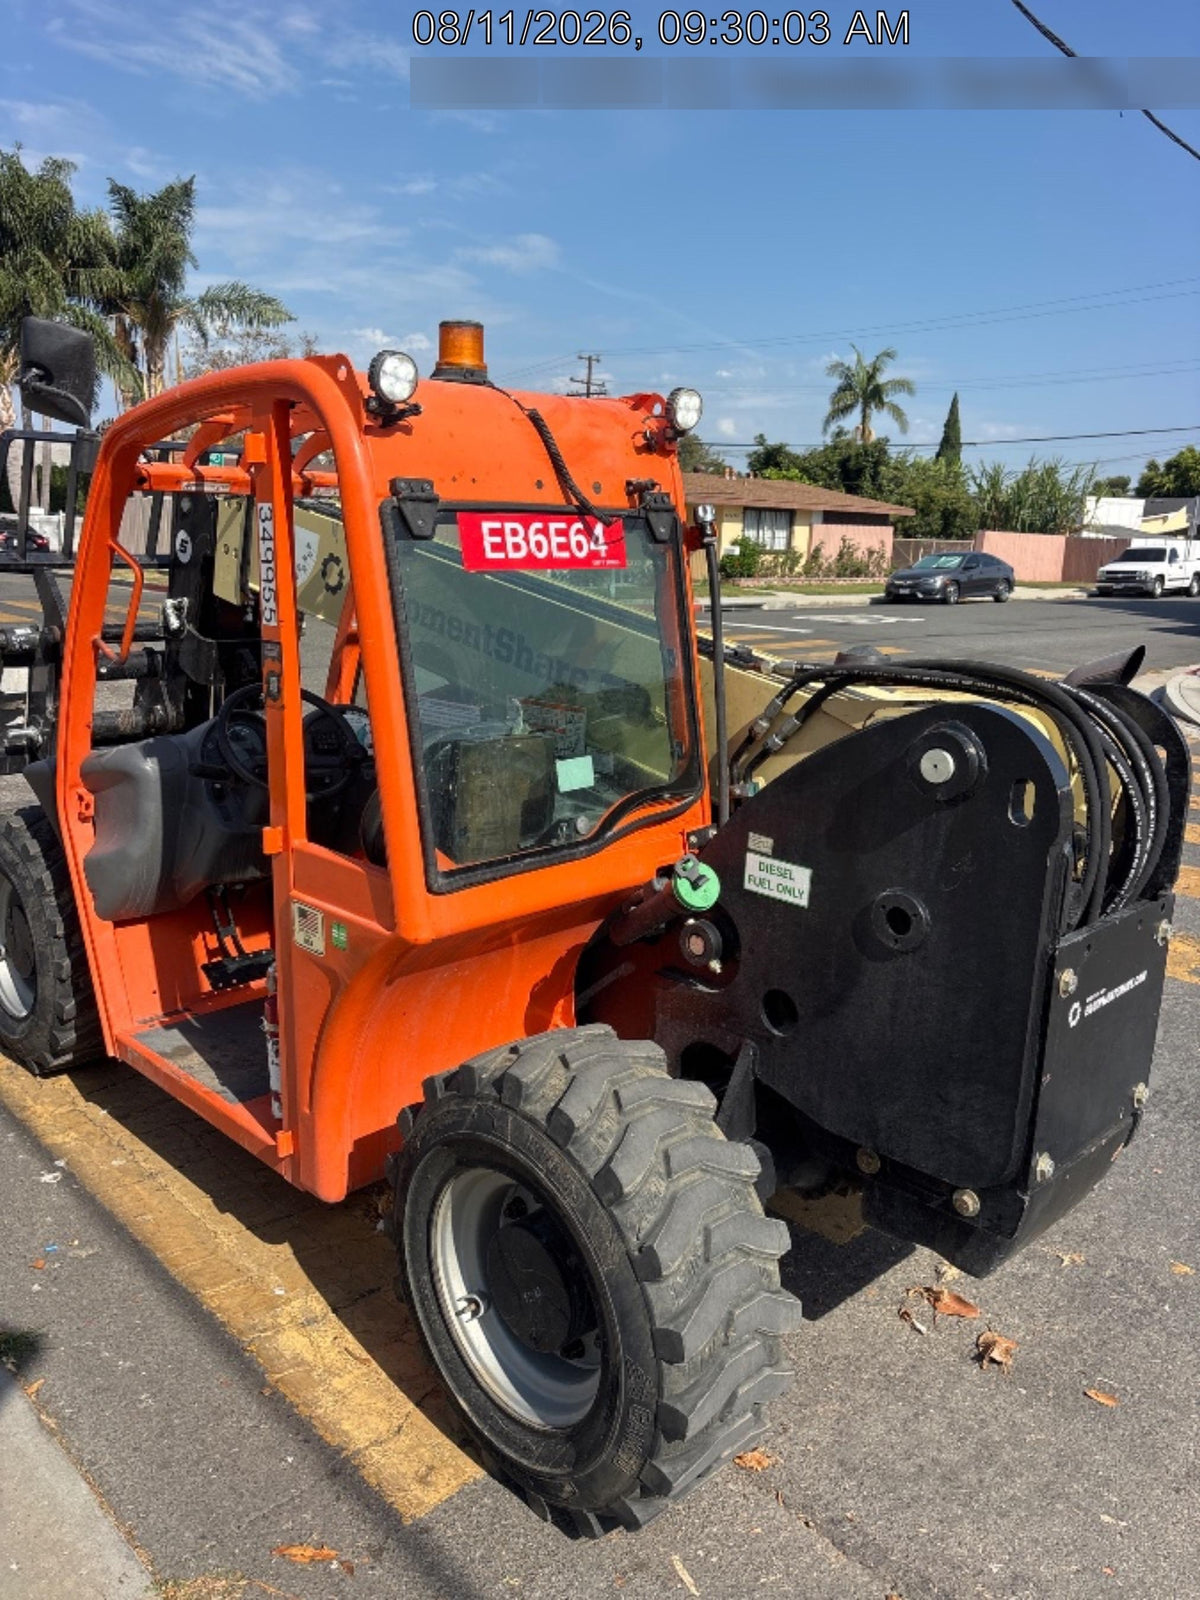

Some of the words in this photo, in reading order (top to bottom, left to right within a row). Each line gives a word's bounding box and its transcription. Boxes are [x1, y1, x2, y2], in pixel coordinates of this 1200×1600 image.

[481, 521, 608, 559] EB6E64
[259, 506, 277, 622] 349955
[748, 874, 774, 892] FUEL
[776, 883, 805, 899] ONLY
[758, 861, 795, 881] DIESEL
